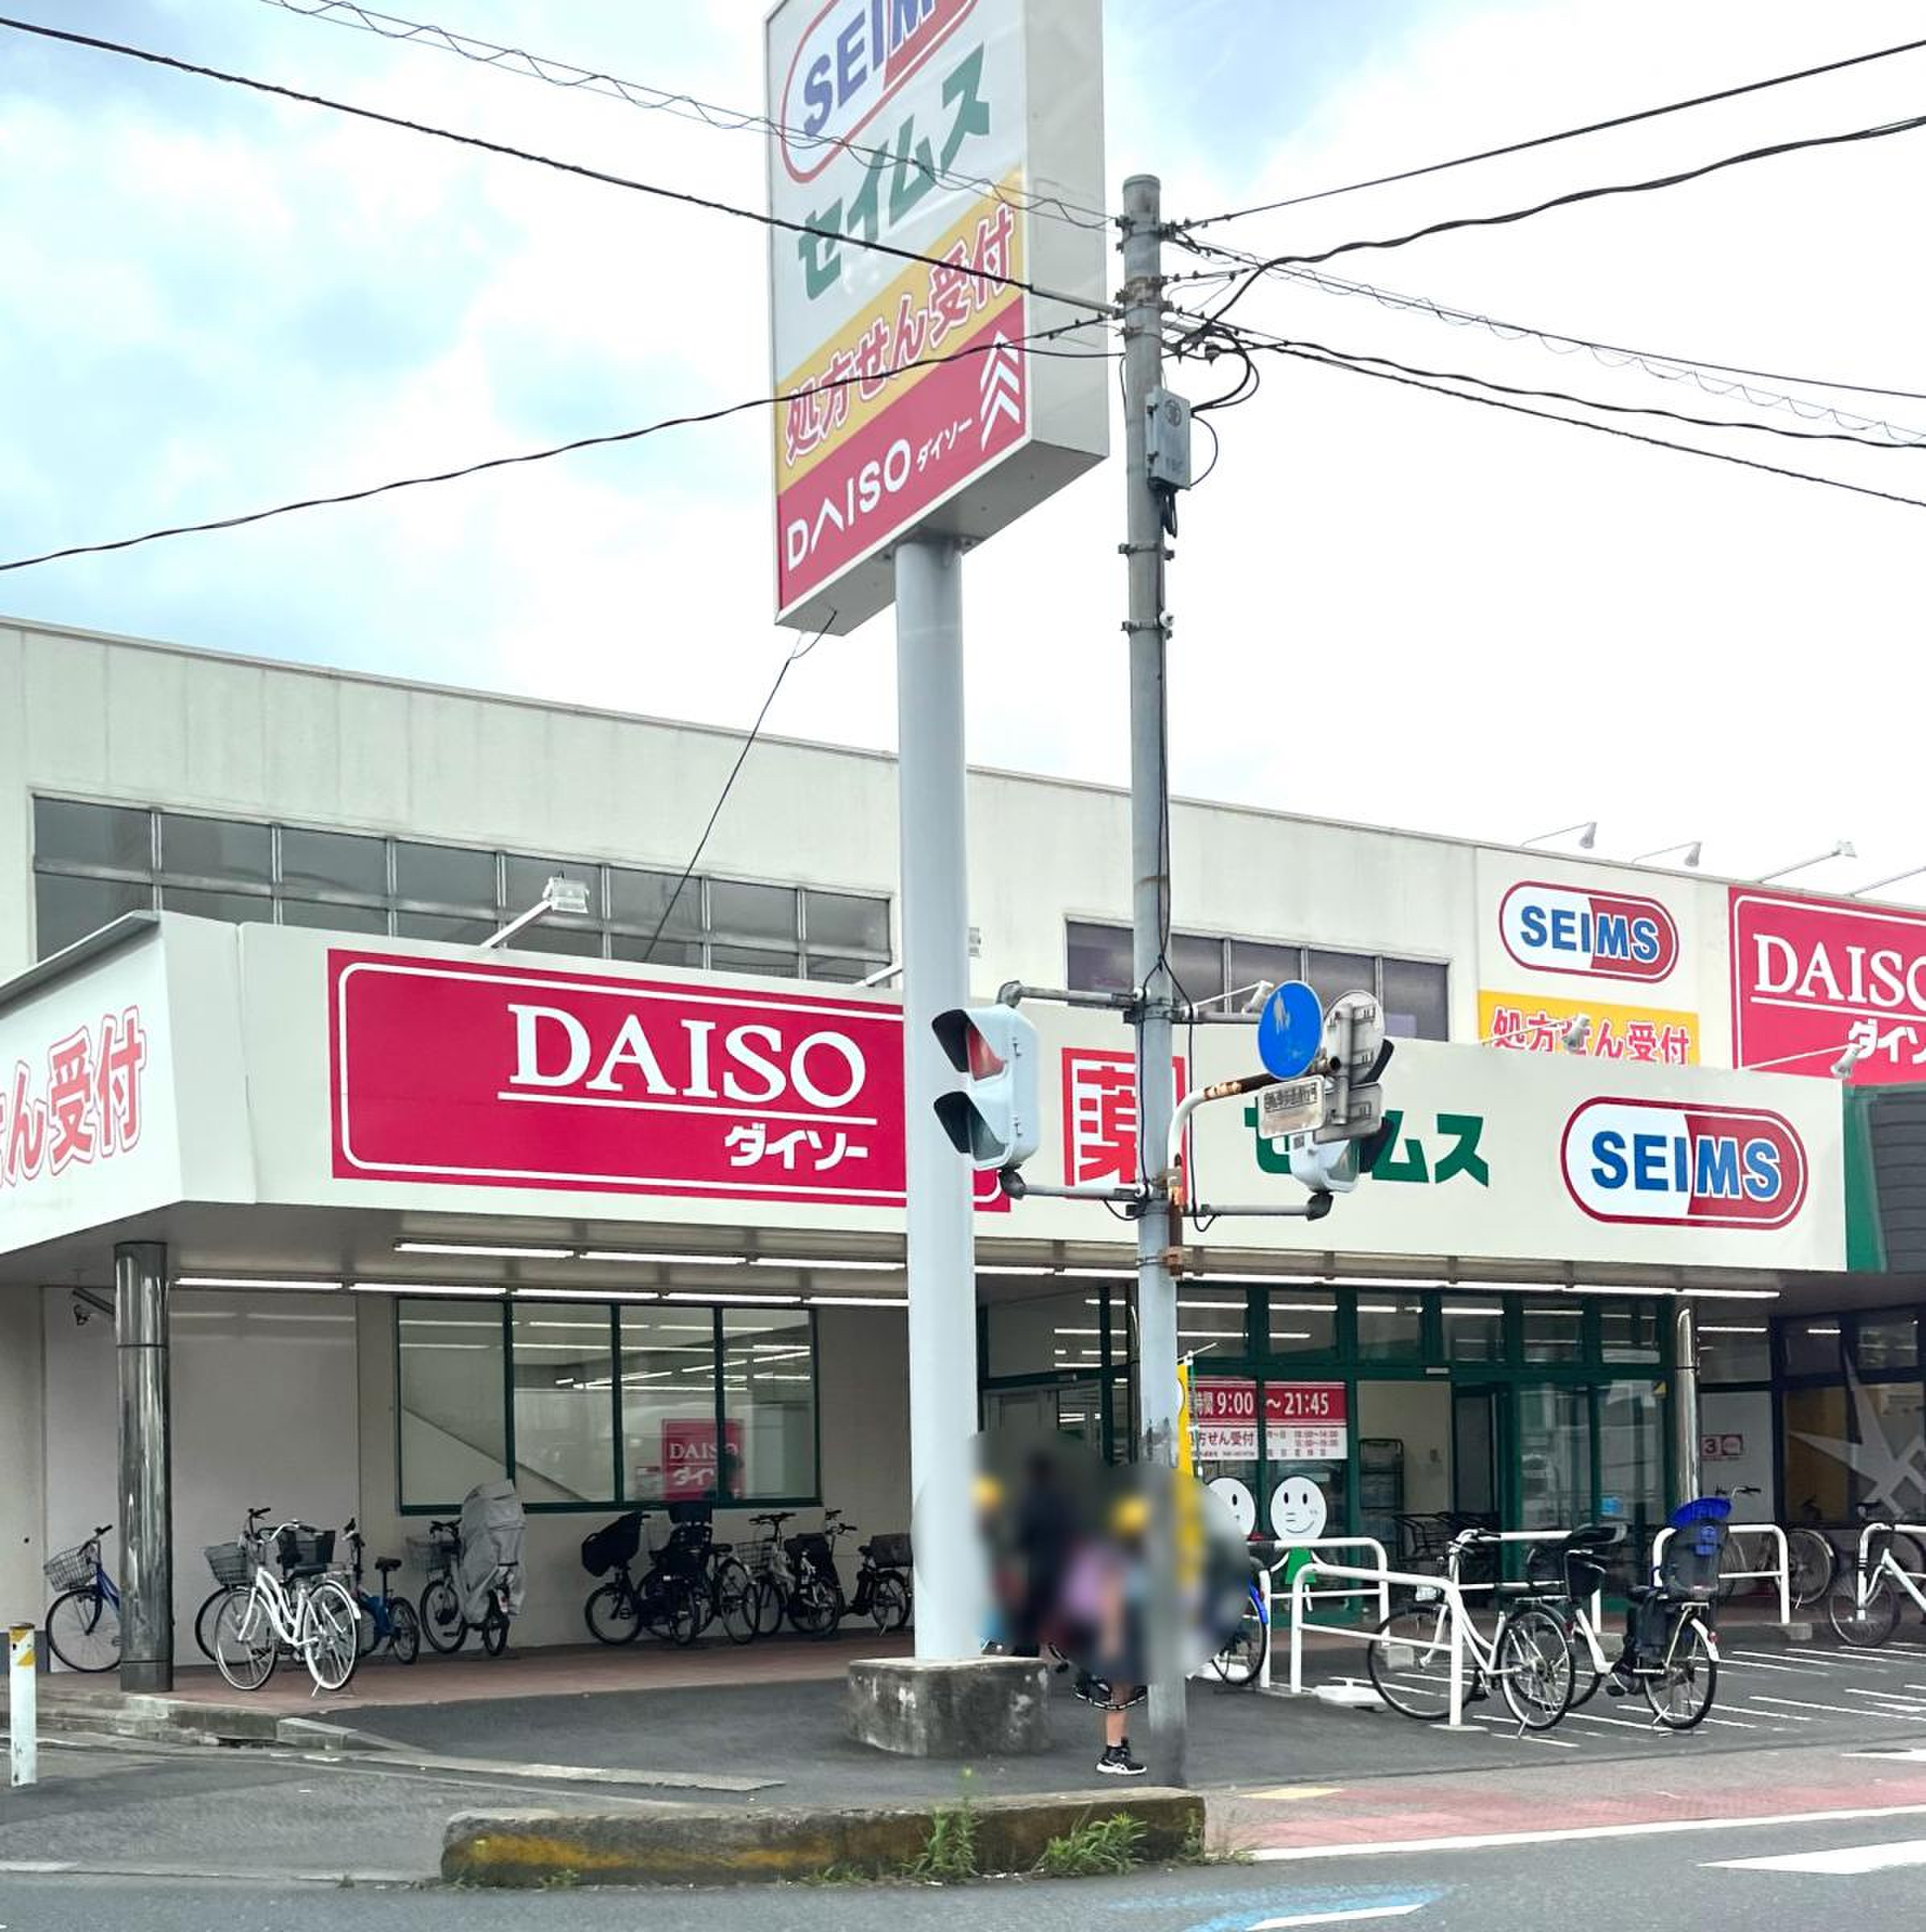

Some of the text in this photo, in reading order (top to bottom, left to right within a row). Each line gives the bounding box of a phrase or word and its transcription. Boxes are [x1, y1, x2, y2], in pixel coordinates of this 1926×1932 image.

[798, 43, 990, 301] セイムス
[786, 202, 1016, 466] 処方せん受付
[917, 418, 972, 472] ダイソー
[787, 439, 911, 572] DAISO
[1520, 905, 1659, 961] SEIMS
[0, 1005, 147, 1187] ん受付
[507, 1004, 866, 1108] DAISO
[725, 1123, 868, 1170] ダイソー
[1590, 1130, 1779, 1200] SEIMS
[1217, 1391, 1254, 1415] 9:00
